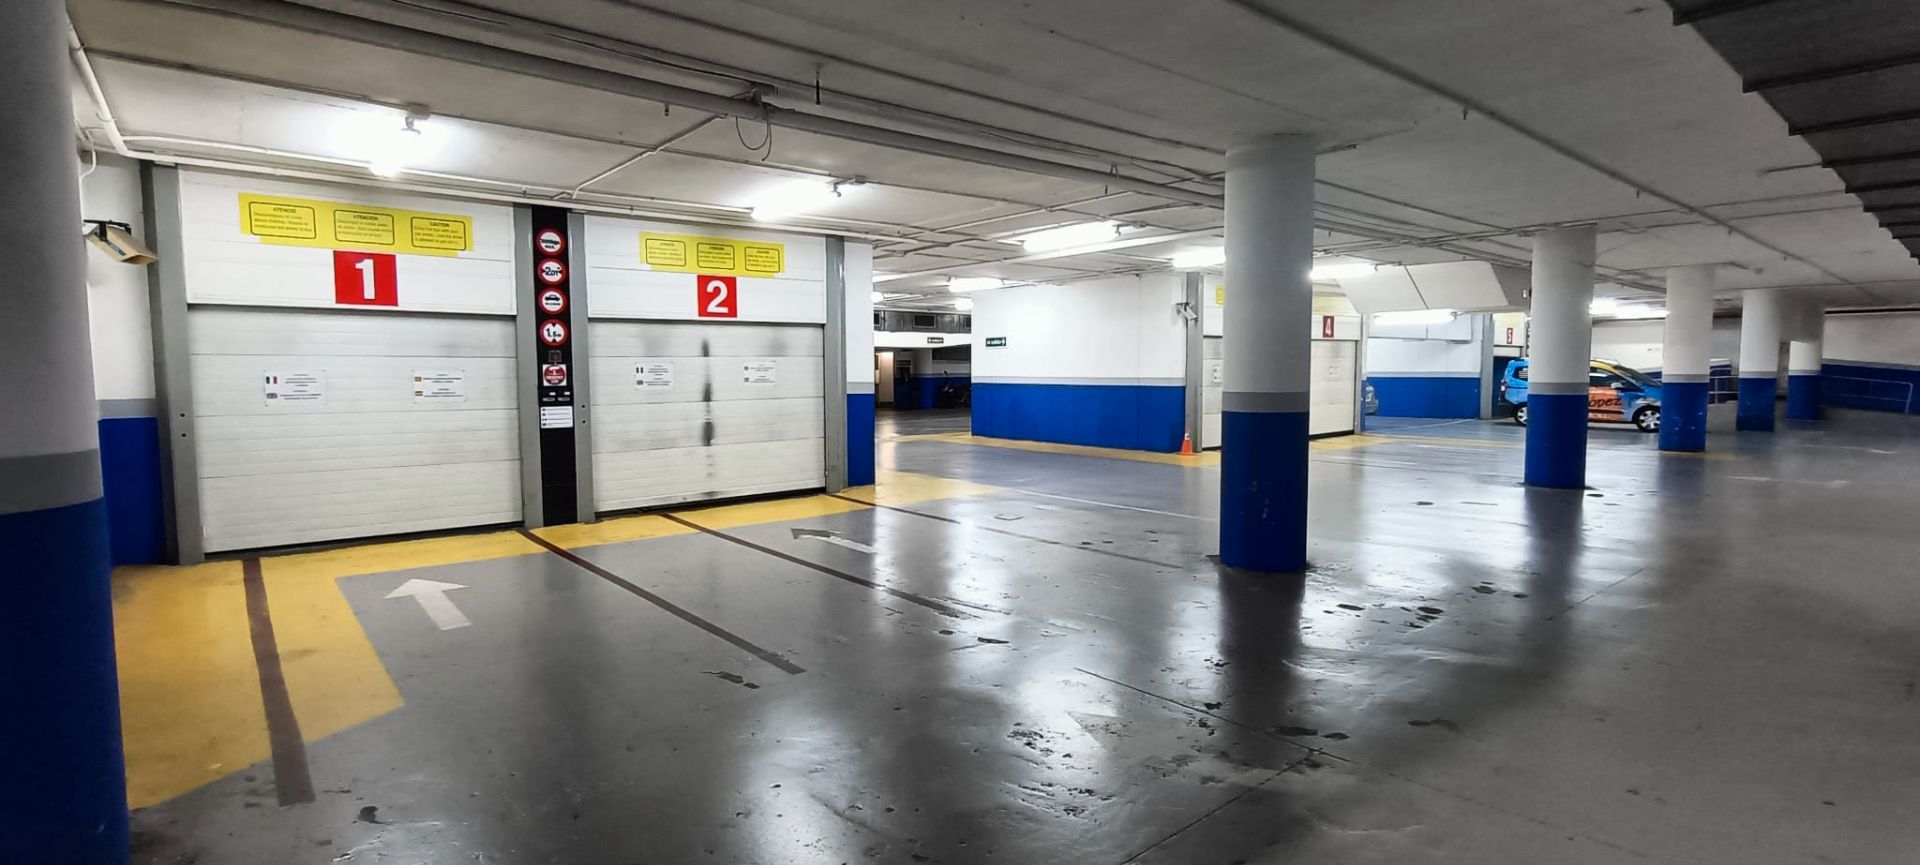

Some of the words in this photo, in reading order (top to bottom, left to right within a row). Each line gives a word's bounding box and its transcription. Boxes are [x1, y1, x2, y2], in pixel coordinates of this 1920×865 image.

[355, 258, 376, 300] 1
[706, 280, 729, 314] 2
[1325, 317, 1333, 336] 4
